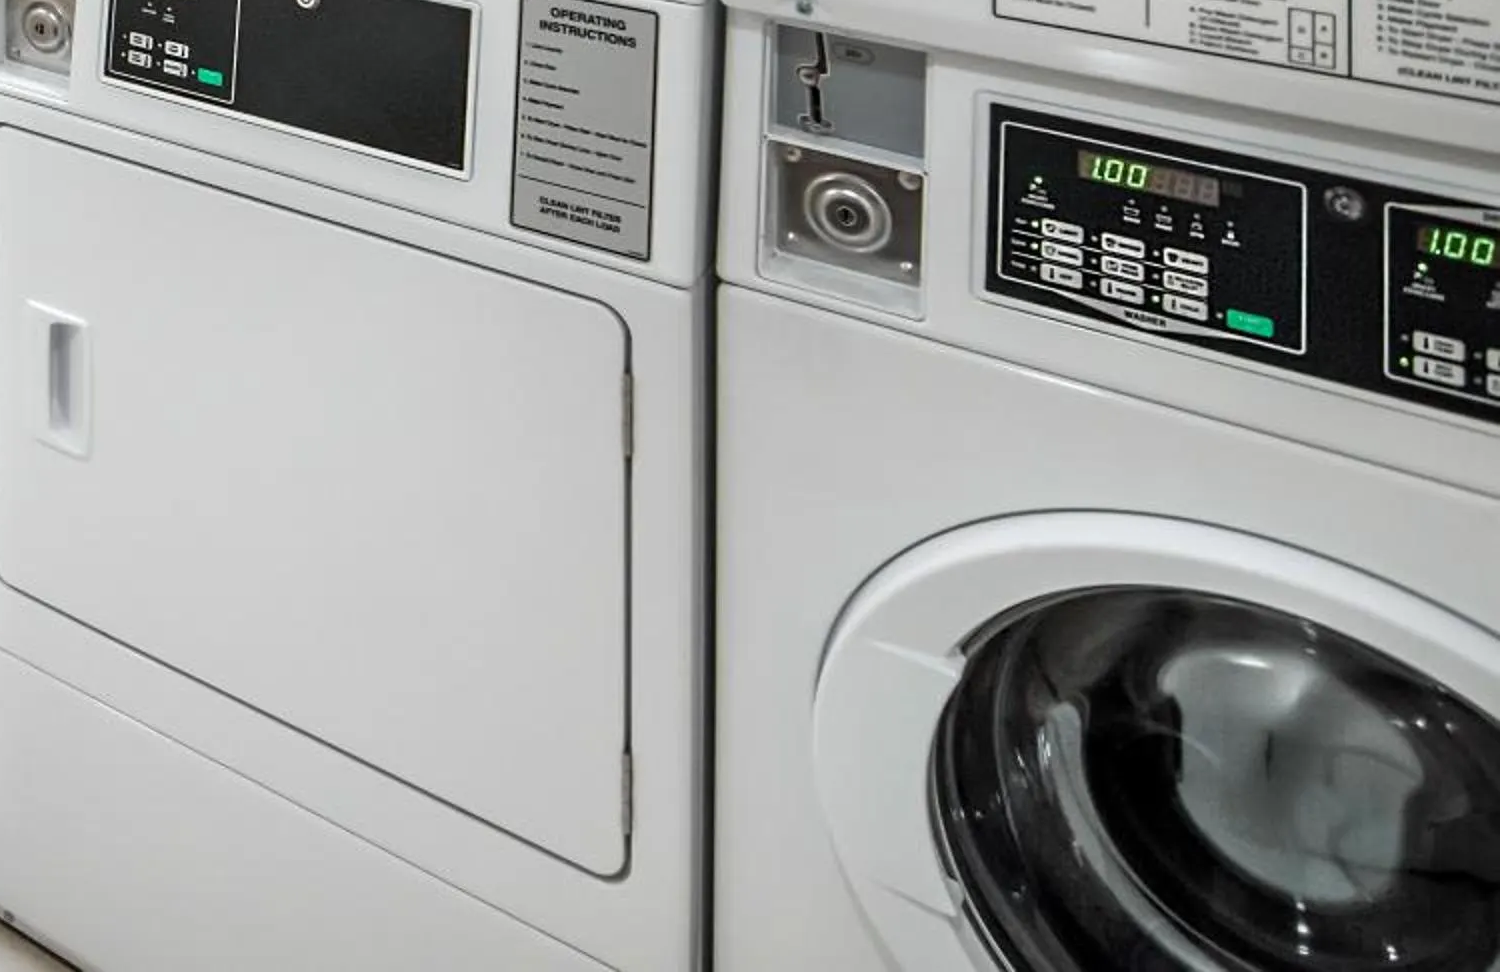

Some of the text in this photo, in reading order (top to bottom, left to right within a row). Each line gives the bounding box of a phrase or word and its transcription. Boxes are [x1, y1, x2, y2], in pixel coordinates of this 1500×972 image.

[539, 19, 637, 49] INSTRUCTIONS
[550, 7, 627, 31] OPERATING
[1429, 228, 1496, 266] 1.00
